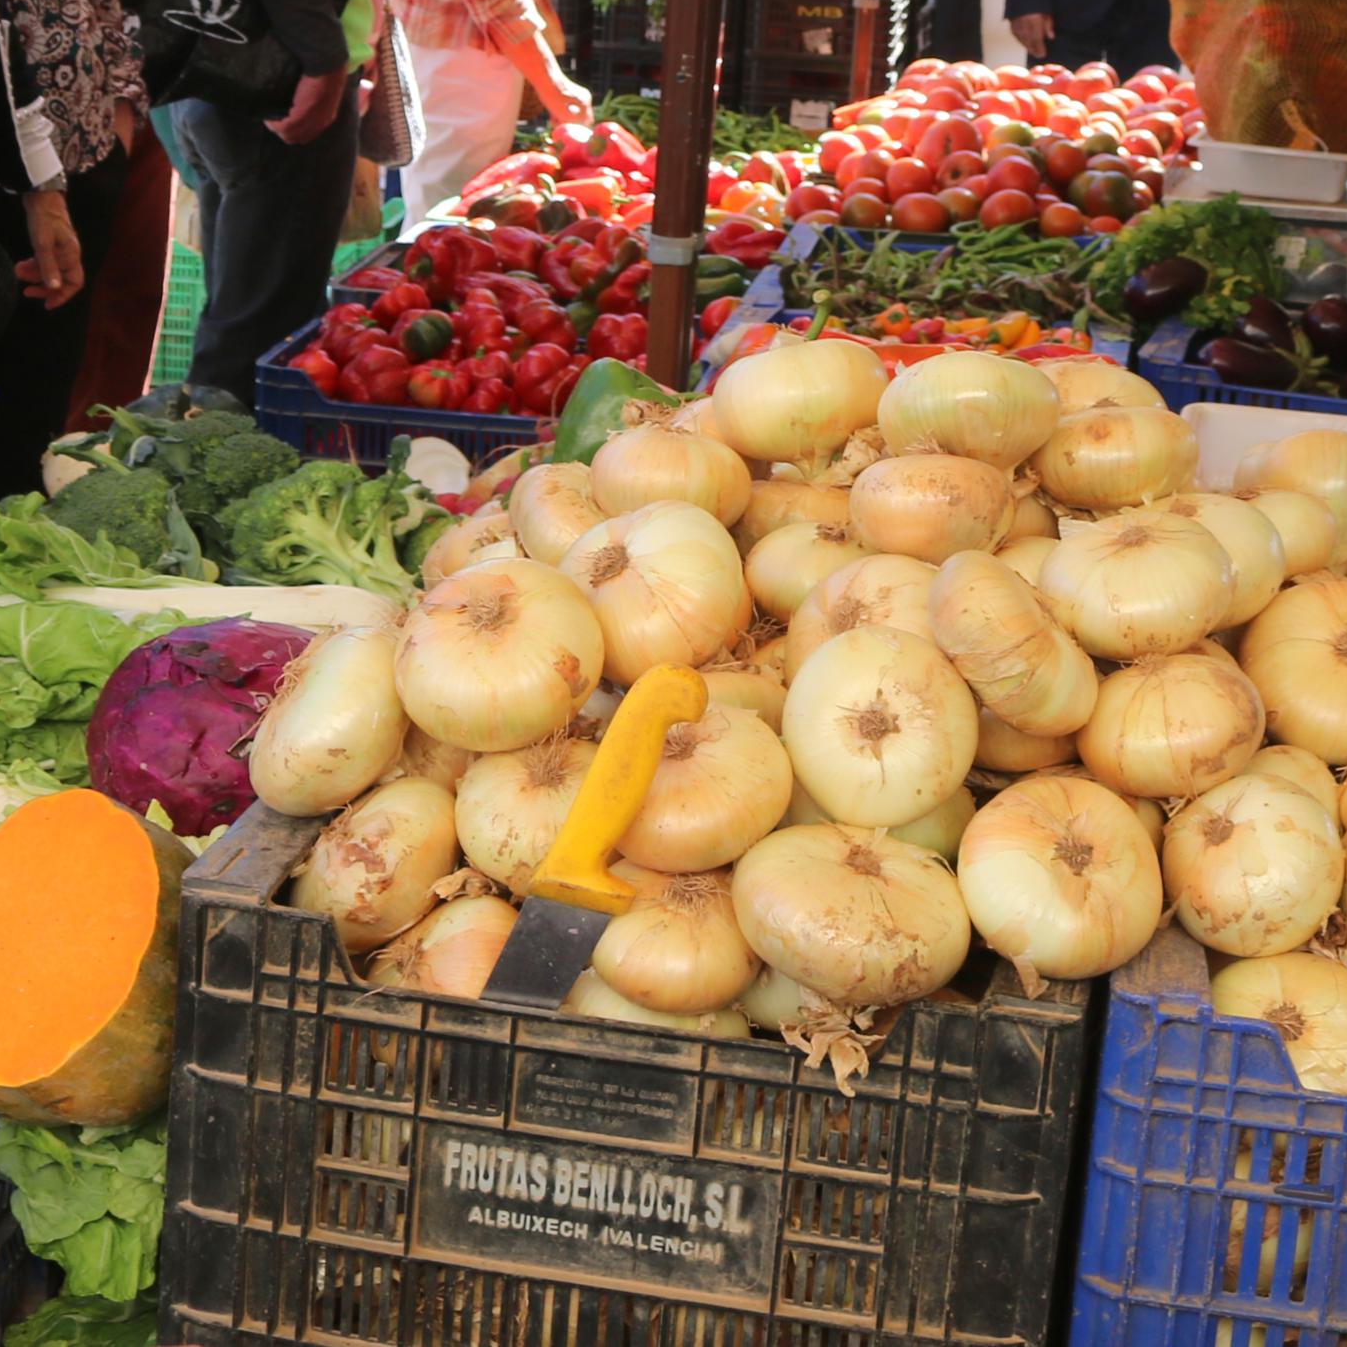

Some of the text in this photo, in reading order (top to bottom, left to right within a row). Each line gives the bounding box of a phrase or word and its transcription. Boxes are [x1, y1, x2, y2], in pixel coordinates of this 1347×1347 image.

[796, 5, 845, 19] MB
[444, 1139, 547, 1202] FRUTAS
[552, 1159, 699, 1234] BENLLOCH,
[468, 1206, 588, 1240] ALBUIXECH
